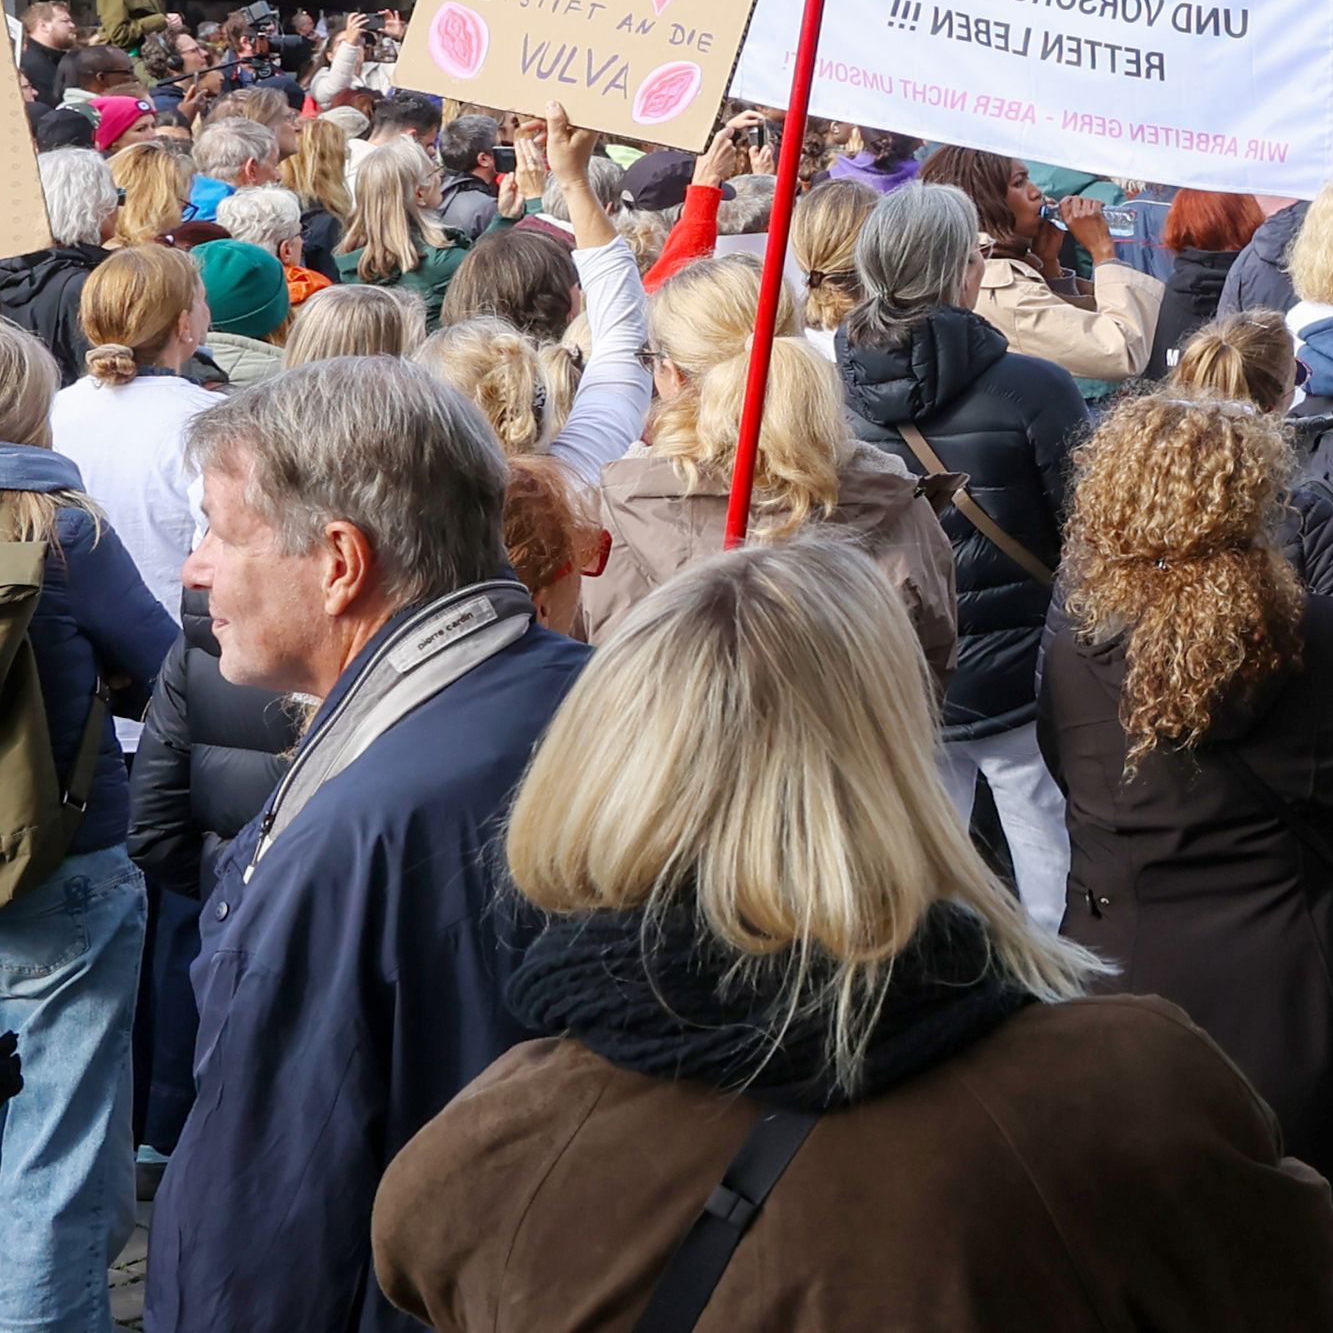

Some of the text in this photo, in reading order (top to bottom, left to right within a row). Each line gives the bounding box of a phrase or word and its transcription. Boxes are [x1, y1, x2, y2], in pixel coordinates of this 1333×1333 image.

[616, 13, 657, 36] AN
[669, 23, 715, 53] DIE
[520, 33, 630, 100] VULVA
[417, 611, 474, 650] pierre cardin
